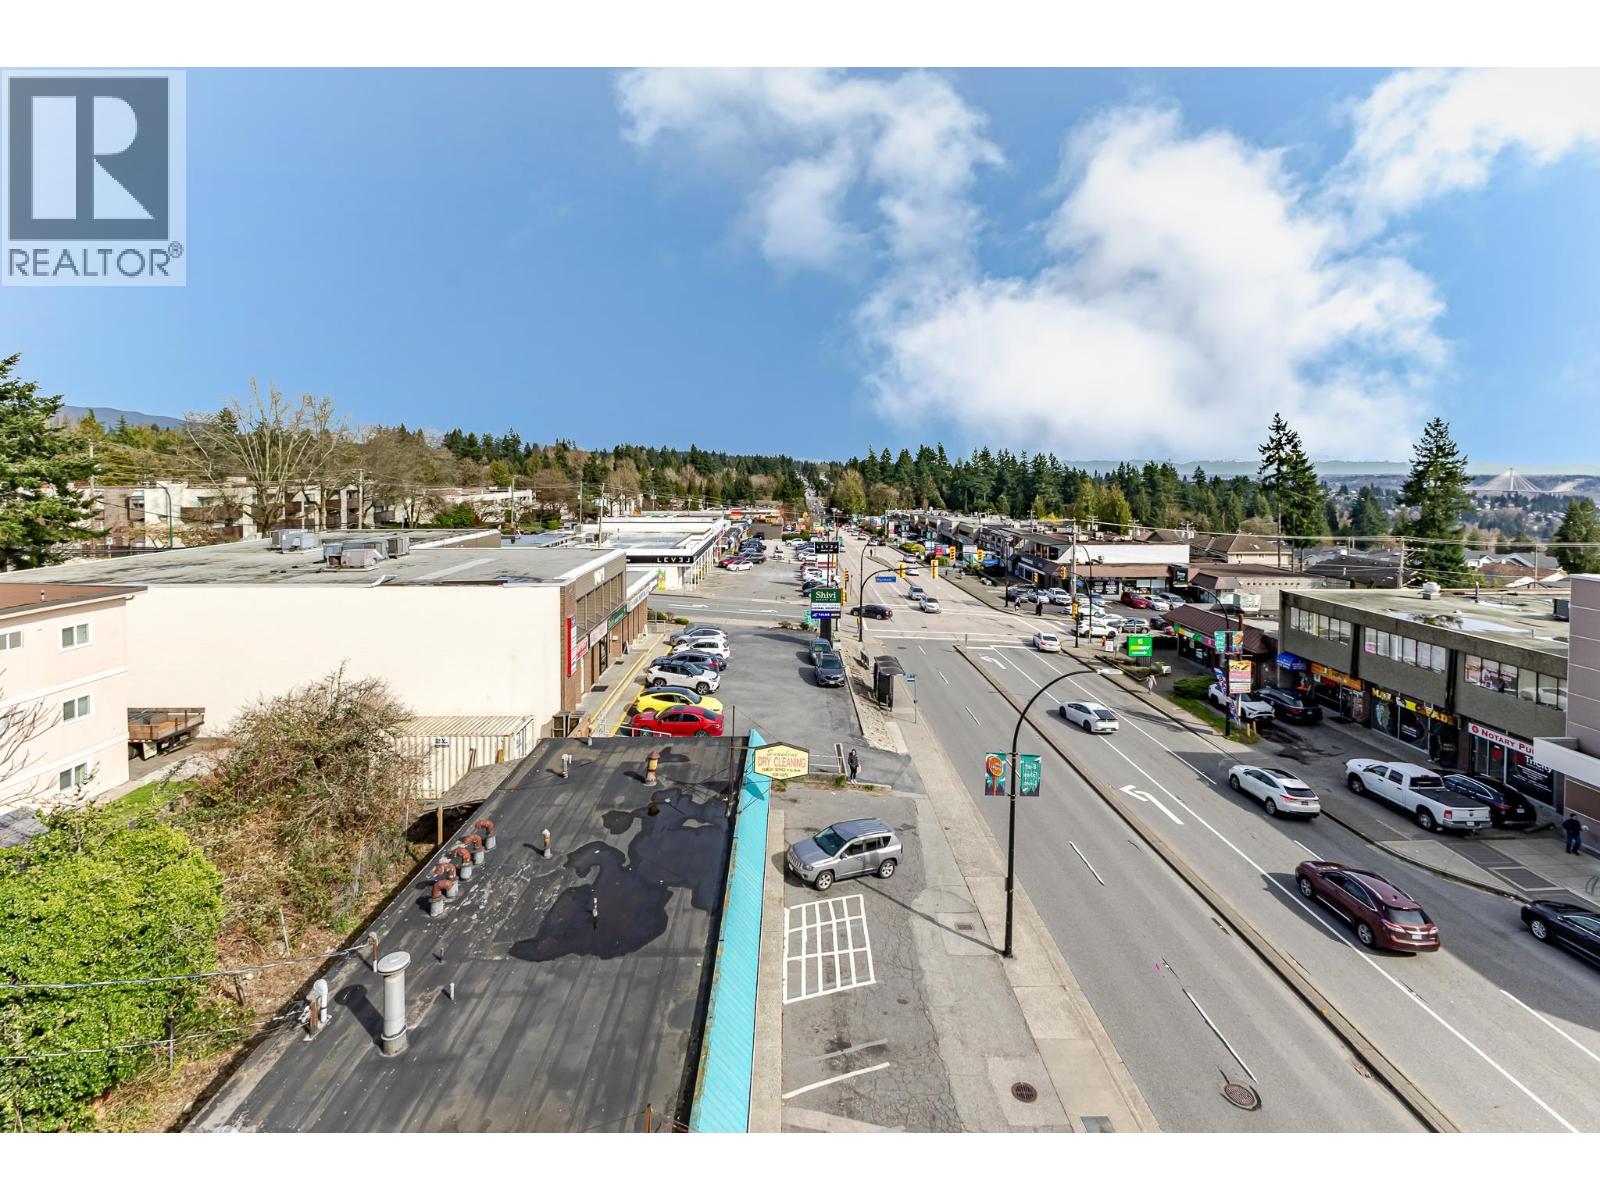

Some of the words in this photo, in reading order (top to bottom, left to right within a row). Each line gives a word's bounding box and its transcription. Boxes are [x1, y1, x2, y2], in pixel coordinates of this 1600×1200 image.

[815, 591, 837, 599] Shivi
[1481, 729, 1516, 748] NOTARY
[757, 756, 772, 768] DRY
[773, 756, 807, 769] CLEANING
